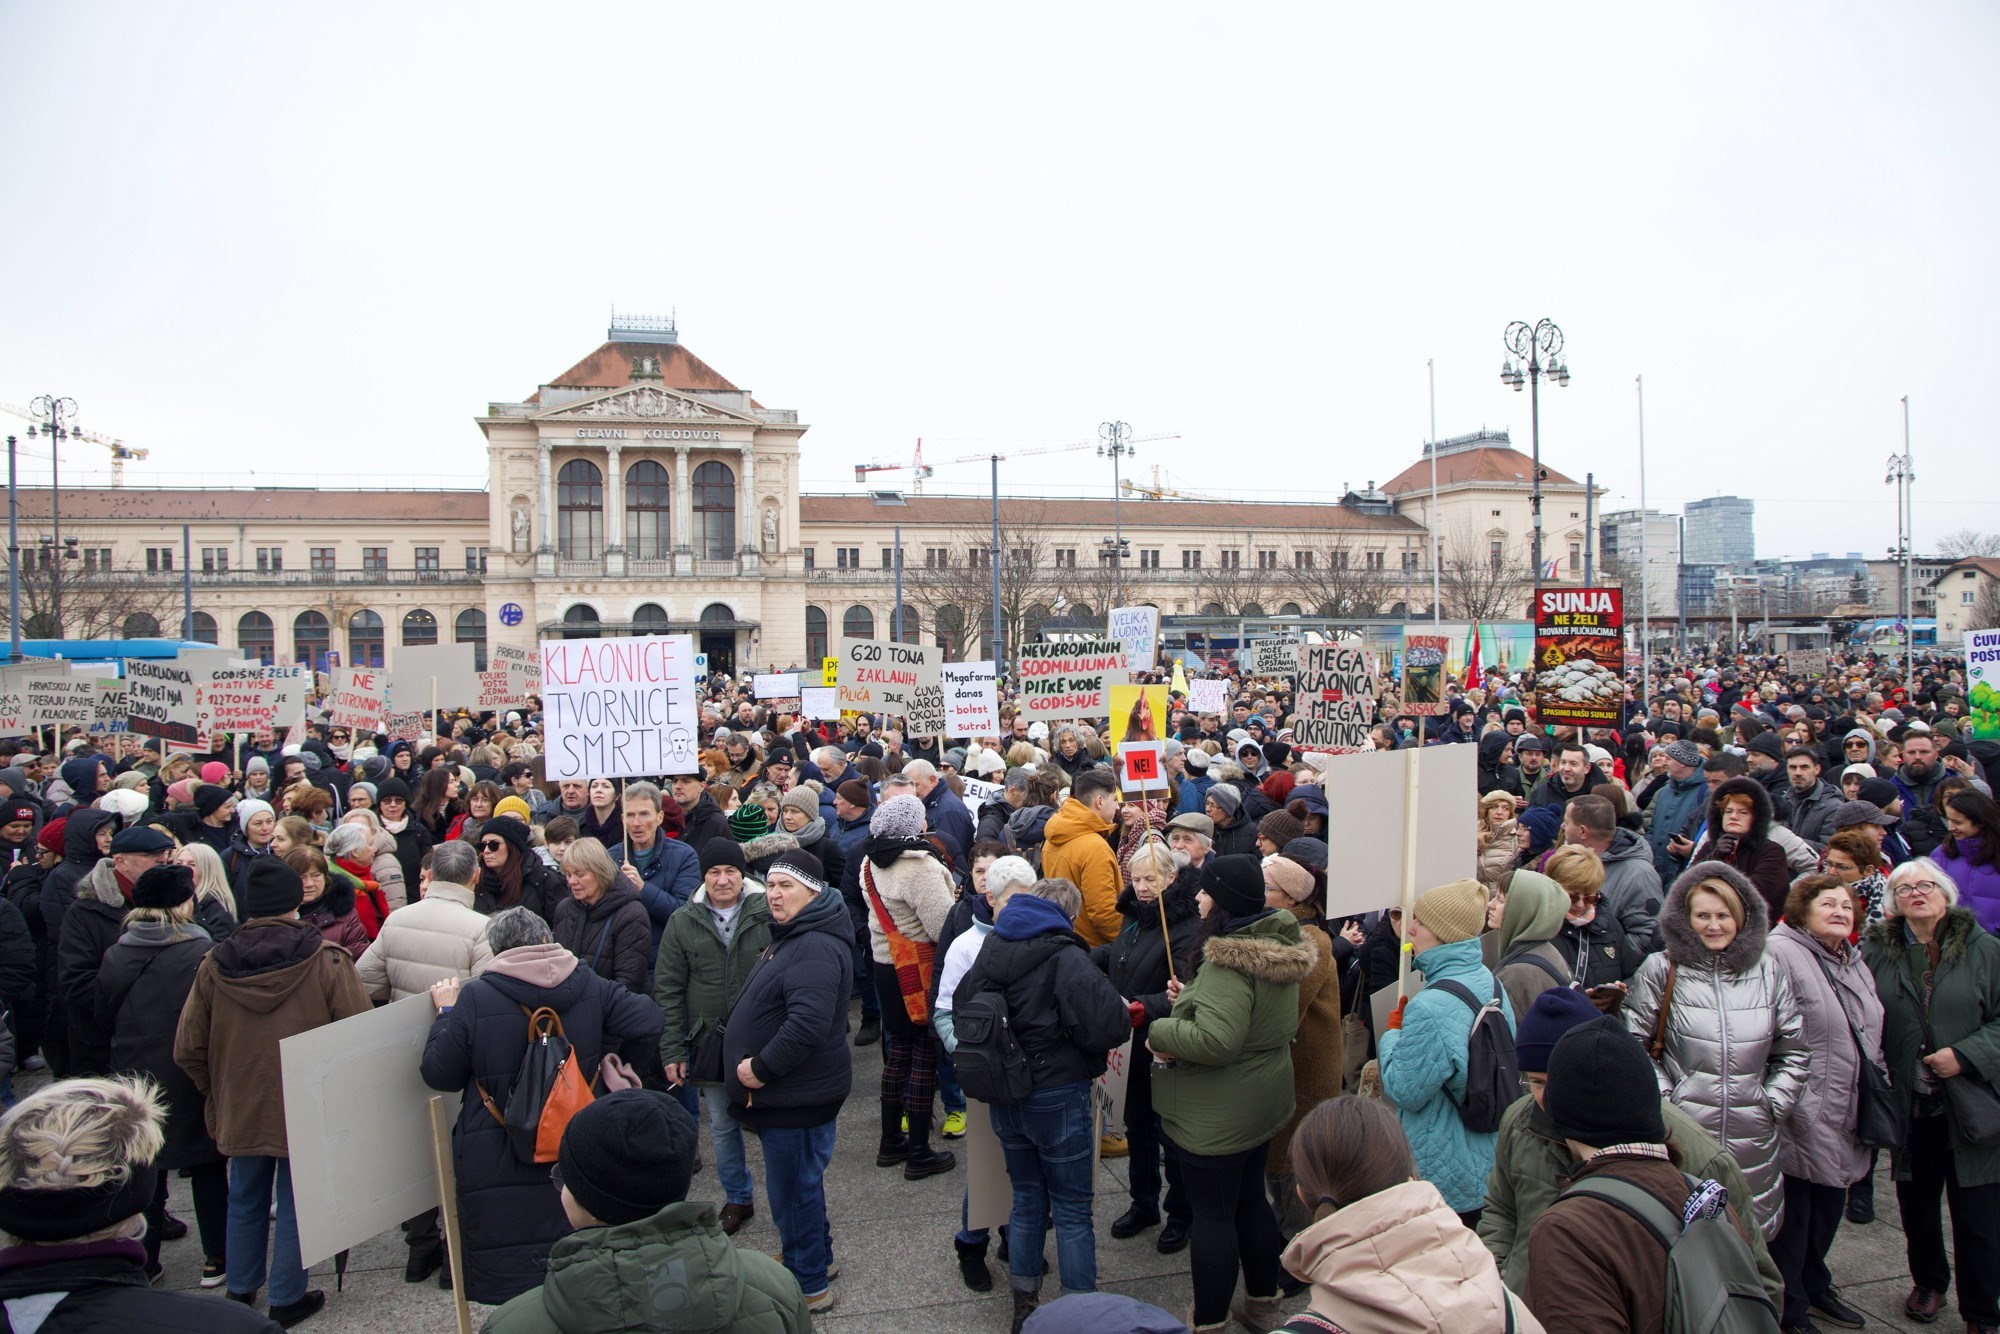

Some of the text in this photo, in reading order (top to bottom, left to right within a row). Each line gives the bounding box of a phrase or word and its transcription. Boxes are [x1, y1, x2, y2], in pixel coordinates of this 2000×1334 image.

[576, 428, 722, 441] GLAVNI KOLODVOR
[1542, 592, 1614, 613] SUNJA
[1113, 612, 1148, 626] VELIKA
[1554, 612, 1598, 625] NE ŽELI
[1112, 625, 1148, 638] LUDINA
[1538, 627, 1570, 636] TROVANJE
[1136, 638, 1152, 652] NE
[1408, 635, 1450, 653] VRISAK
[1973, 634, 2000, 647] ČUV
[496, 646, 525, 660] PRIRODA
[528, 652, 537, 663] NE
[850, 644, 925, 666] 620 TONA
[1021, 641, 1121, 659] NEVJEROJATNIH
[1260, 646, 1282, 654] MOŽE
[492, 658, 508, 670] BITI
[544, 642, 679, 685] KLAONICE
[1309, 648, 1365, 674] MEGA
[128, 662, 192, 686] MEGAKLAONICA
[212, 668, 265, 680] GODIŠNJE
[478, 672, 507, 680] KOLIKO
[856, 668, 917, 686] ZAKLANIH
[945, 672, 996, 686] Megafarma
[28, 682, 92, 693] HRVATSKOJ NE
[352, 673, 376, 690] NE
[482, 680, 508, 688] KOŠTA
[1024, 676, 1103, 694] PITKE VODE
[1193, 680, 1222, 690] TIŠINA
[1296, 670, 1373, 696] KLAONICA
[128, 682, 138, 696] JE
[482, 688, 508, 696] JEDNA
[839, 685, 870, 703] PILIĆA
[954, 688, 984, 698] danas
[28, 694, 95, 707] TREBAJU FARME
[101, 692, 128, 704] NE
[226, 694, 261, 704] TONE
[274, 694, 287, 702] JE
[337, 692, 382, 714] OTROVNIM
[478, 694, 526, 706] ŽUPANIJA?
[1029, 691, 1102, 710] GODIŠNJE
[32, 708, 88, 721] I KLAONICE
[129, 700, 168, 722] ZDRAVOJ
[547, 688, 682, 728] TVORNICE
[1311, 700, 1366, 722] MEGA
[1404, 702, 1438, 716] SISAK
[1542, 708, 1617, 720] SPASIMO NAŠU SUNJU!
[408, 716, 418, 724] TO
[958, 719, 991, 731] sutra!
[910, 722, 922, 734] NE
[1294, 719, 1373, 747] OKRUTNOST
[560, 728, 662, 776] SMRTI
[1134, 758, 1150, 773] NE!
